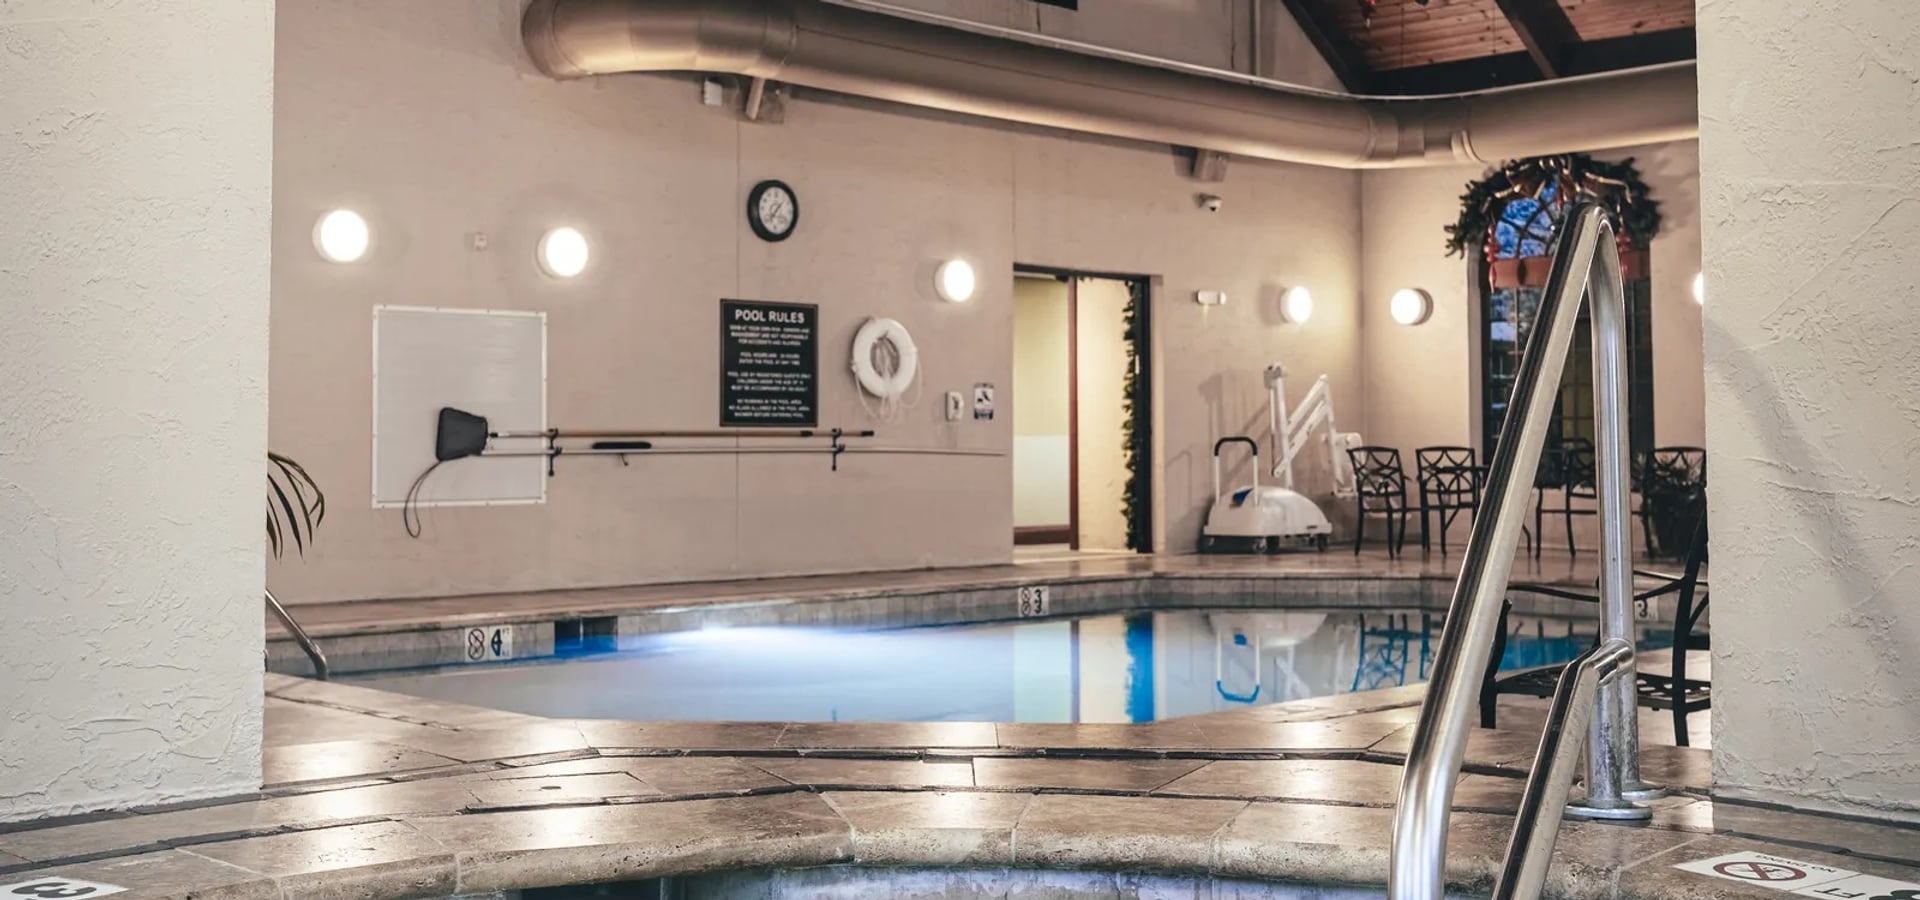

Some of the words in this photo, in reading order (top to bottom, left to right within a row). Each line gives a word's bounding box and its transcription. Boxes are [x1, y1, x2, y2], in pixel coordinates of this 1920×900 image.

[735, 309, 766, 321] POOL
[769, 311, 805, 323] RULES
[11, 882, 97, 898] 3
[1813, 887, 1866, 898] FT
